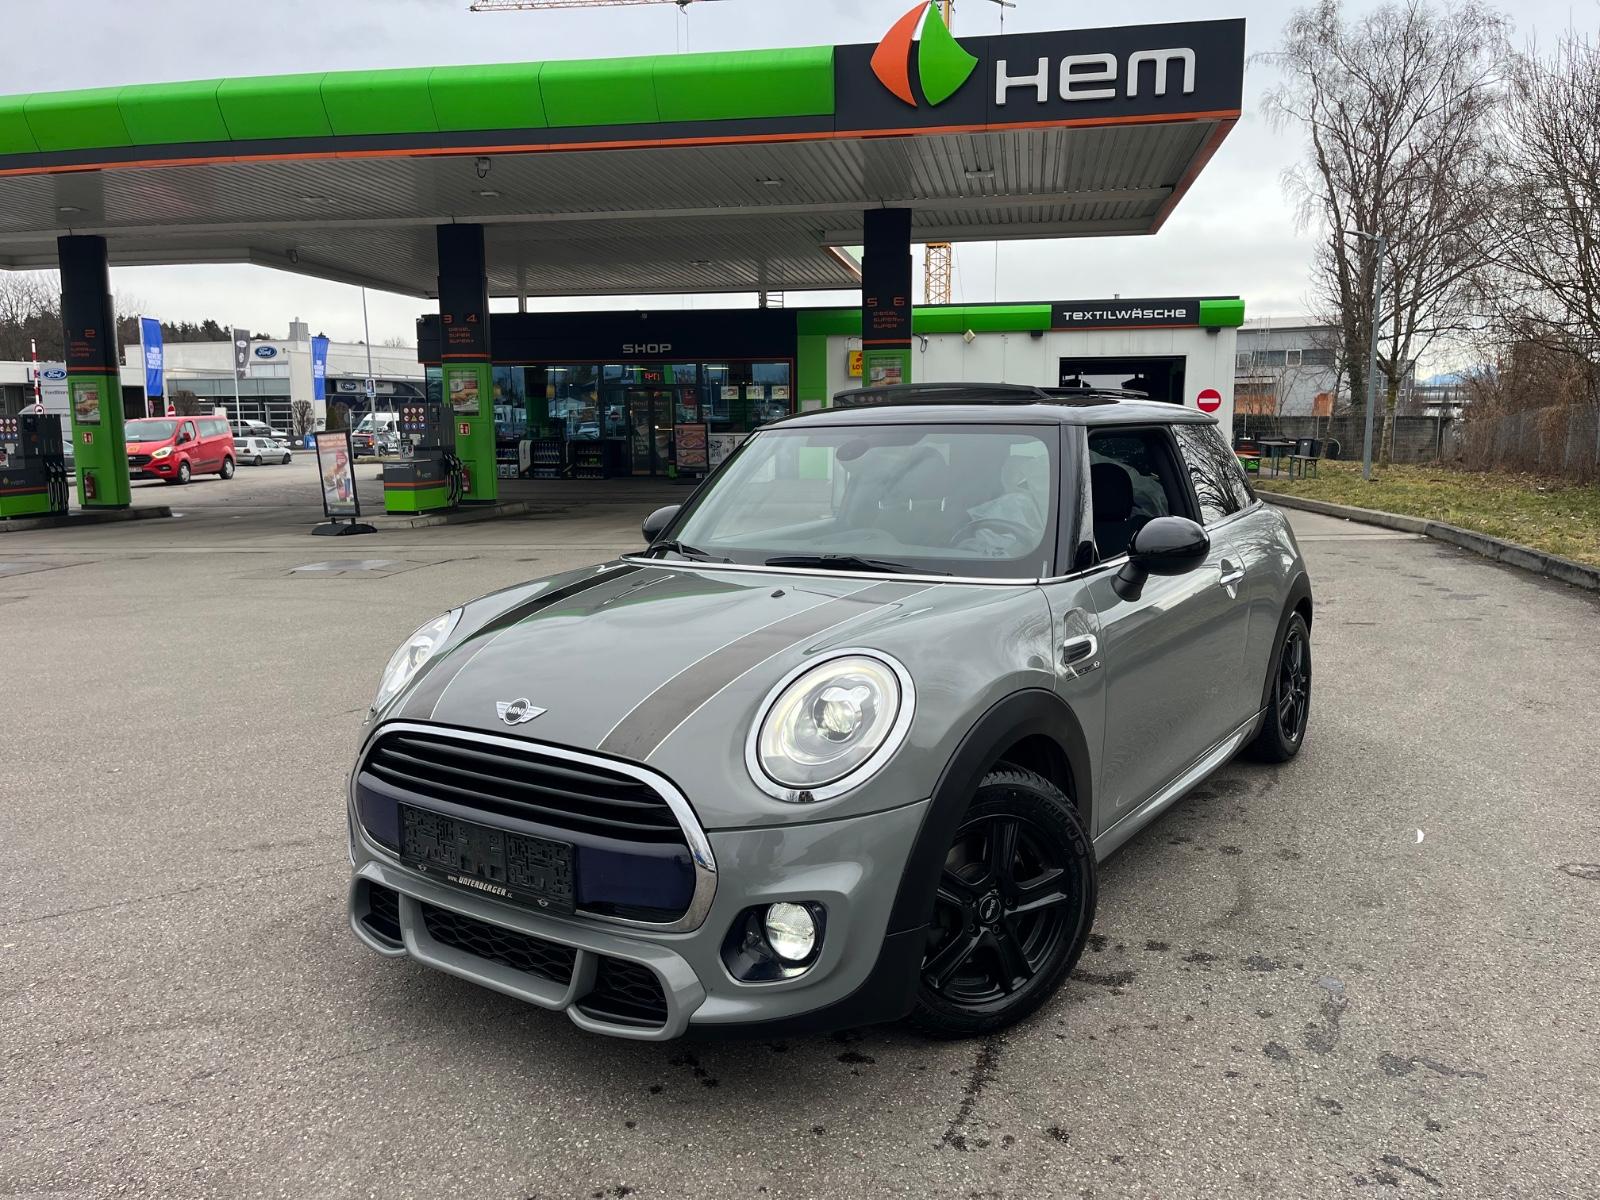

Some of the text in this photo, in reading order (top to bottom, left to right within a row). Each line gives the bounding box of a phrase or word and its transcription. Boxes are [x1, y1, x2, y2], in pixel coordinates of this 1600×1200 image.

[867, 296, 905, 308] 5 6
[443, 314, 478, 324] 3 4
[84, 329, 96, 338] 2
[622, 343, 672, 353] SHOP
[507, 705, 527, 716] MINI
